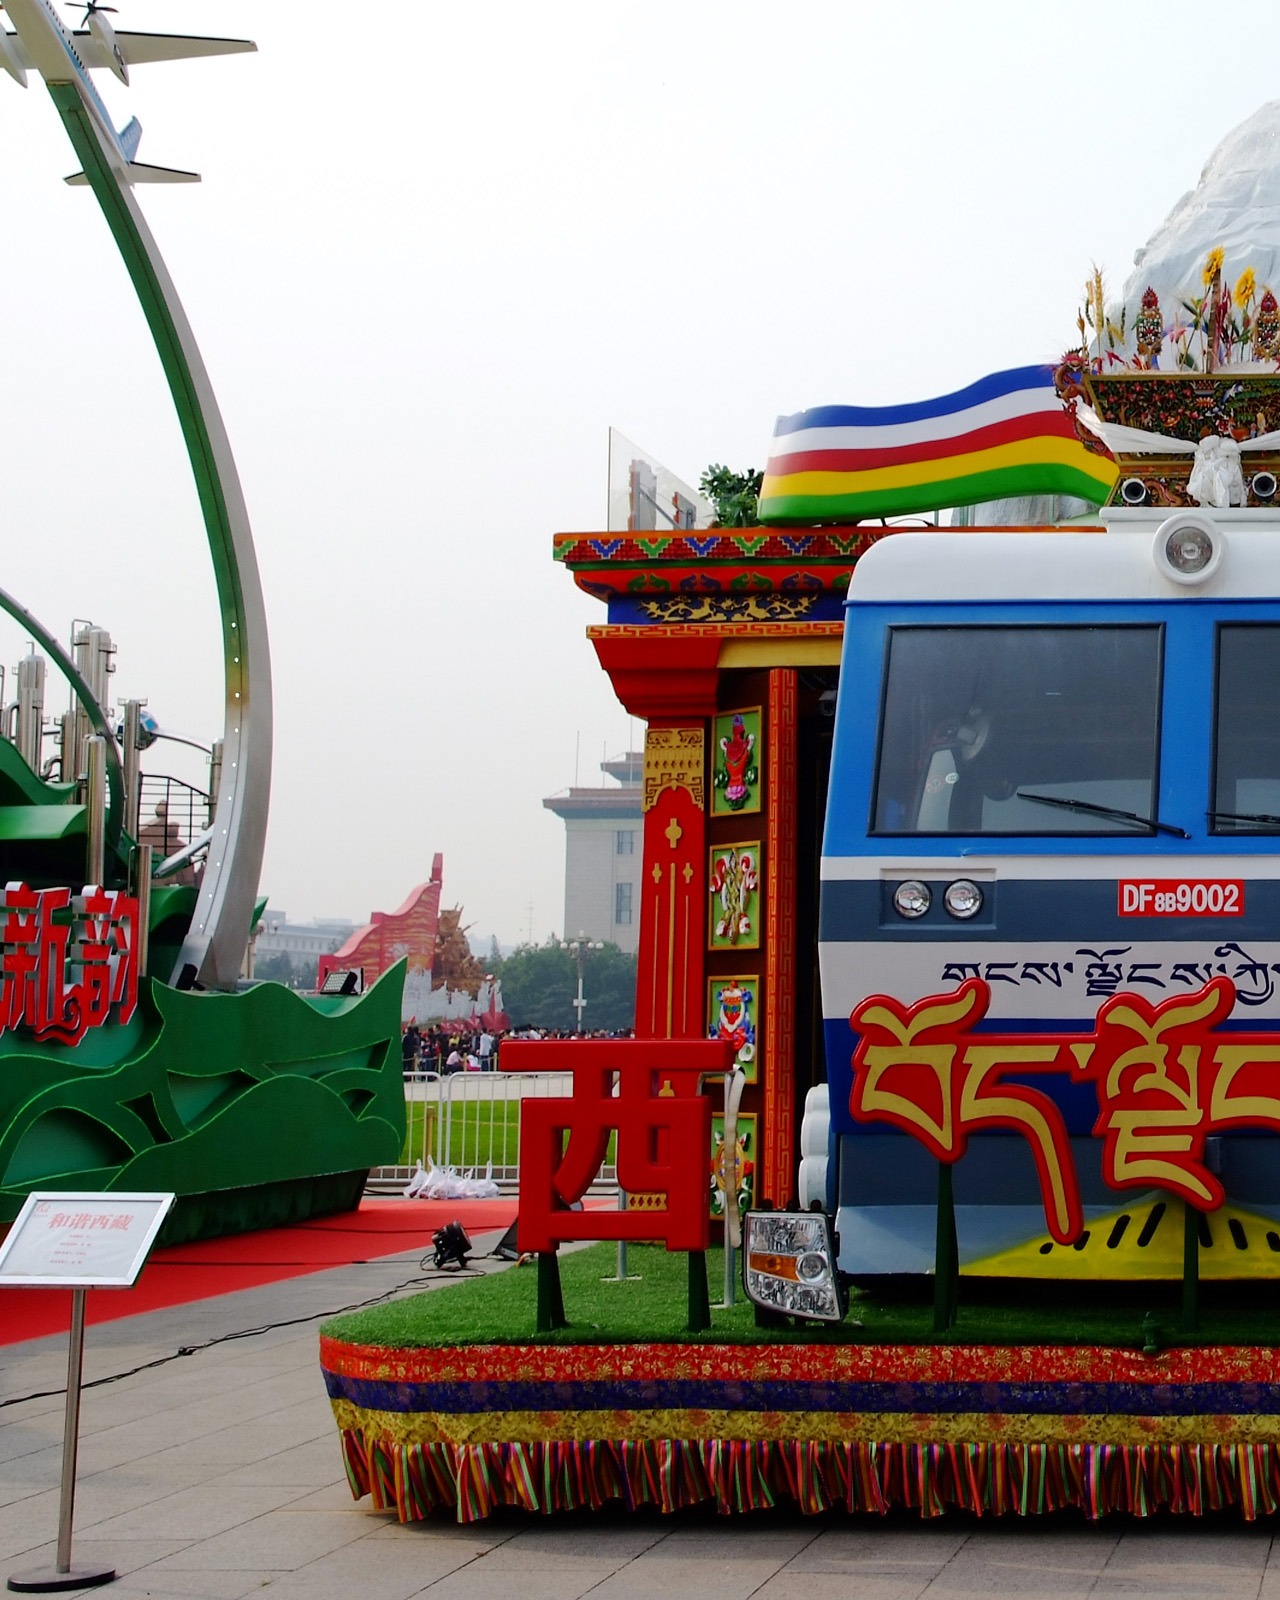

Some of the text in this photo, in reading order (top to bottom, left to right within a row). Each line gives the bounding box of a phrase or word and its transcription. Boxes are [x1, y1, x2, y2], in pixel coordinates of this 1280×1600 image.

[1123, 884, 1239, 912] DF8B9002
[48, 1212, 134, 1231] 和谐西藏
